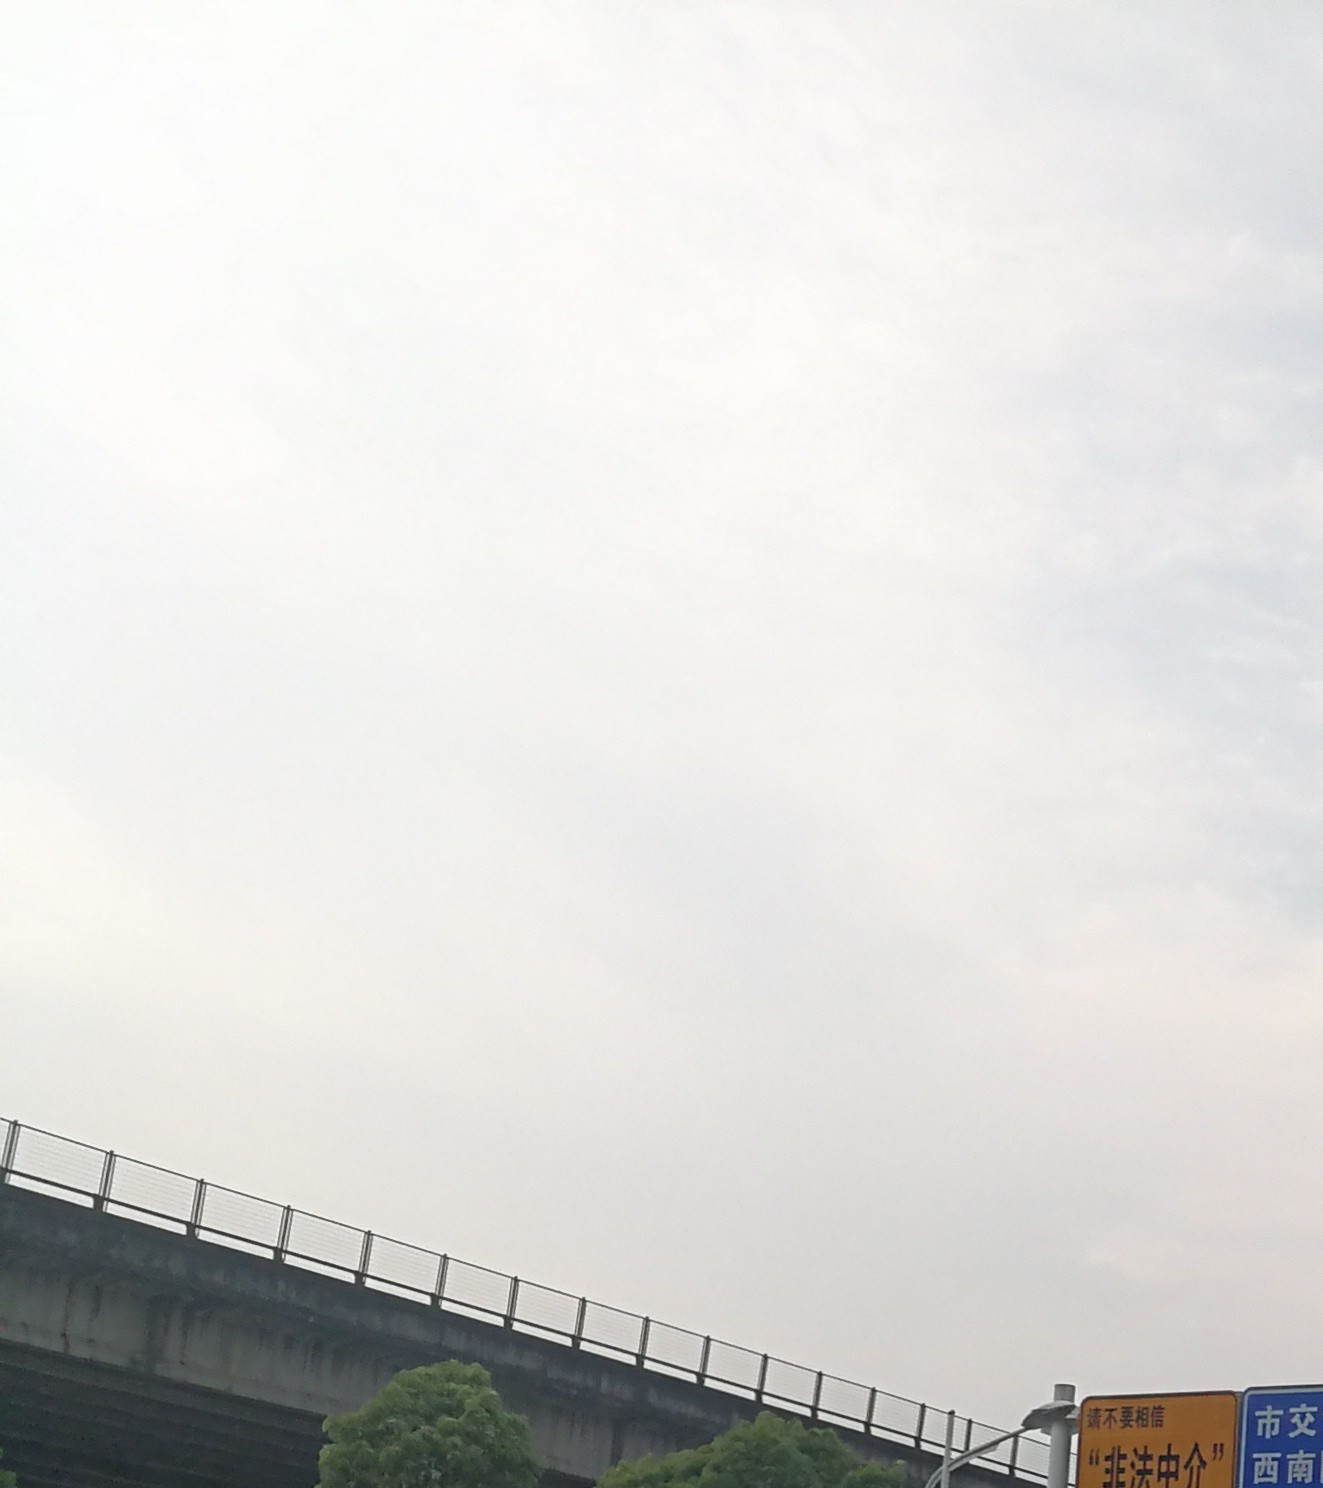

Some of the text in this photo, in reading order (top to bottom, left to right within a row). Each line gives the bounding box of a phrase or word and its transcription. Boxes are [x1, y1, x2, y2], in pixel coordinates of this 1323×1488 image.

[1087, 1405, 1165, 1430] 请不要相信
